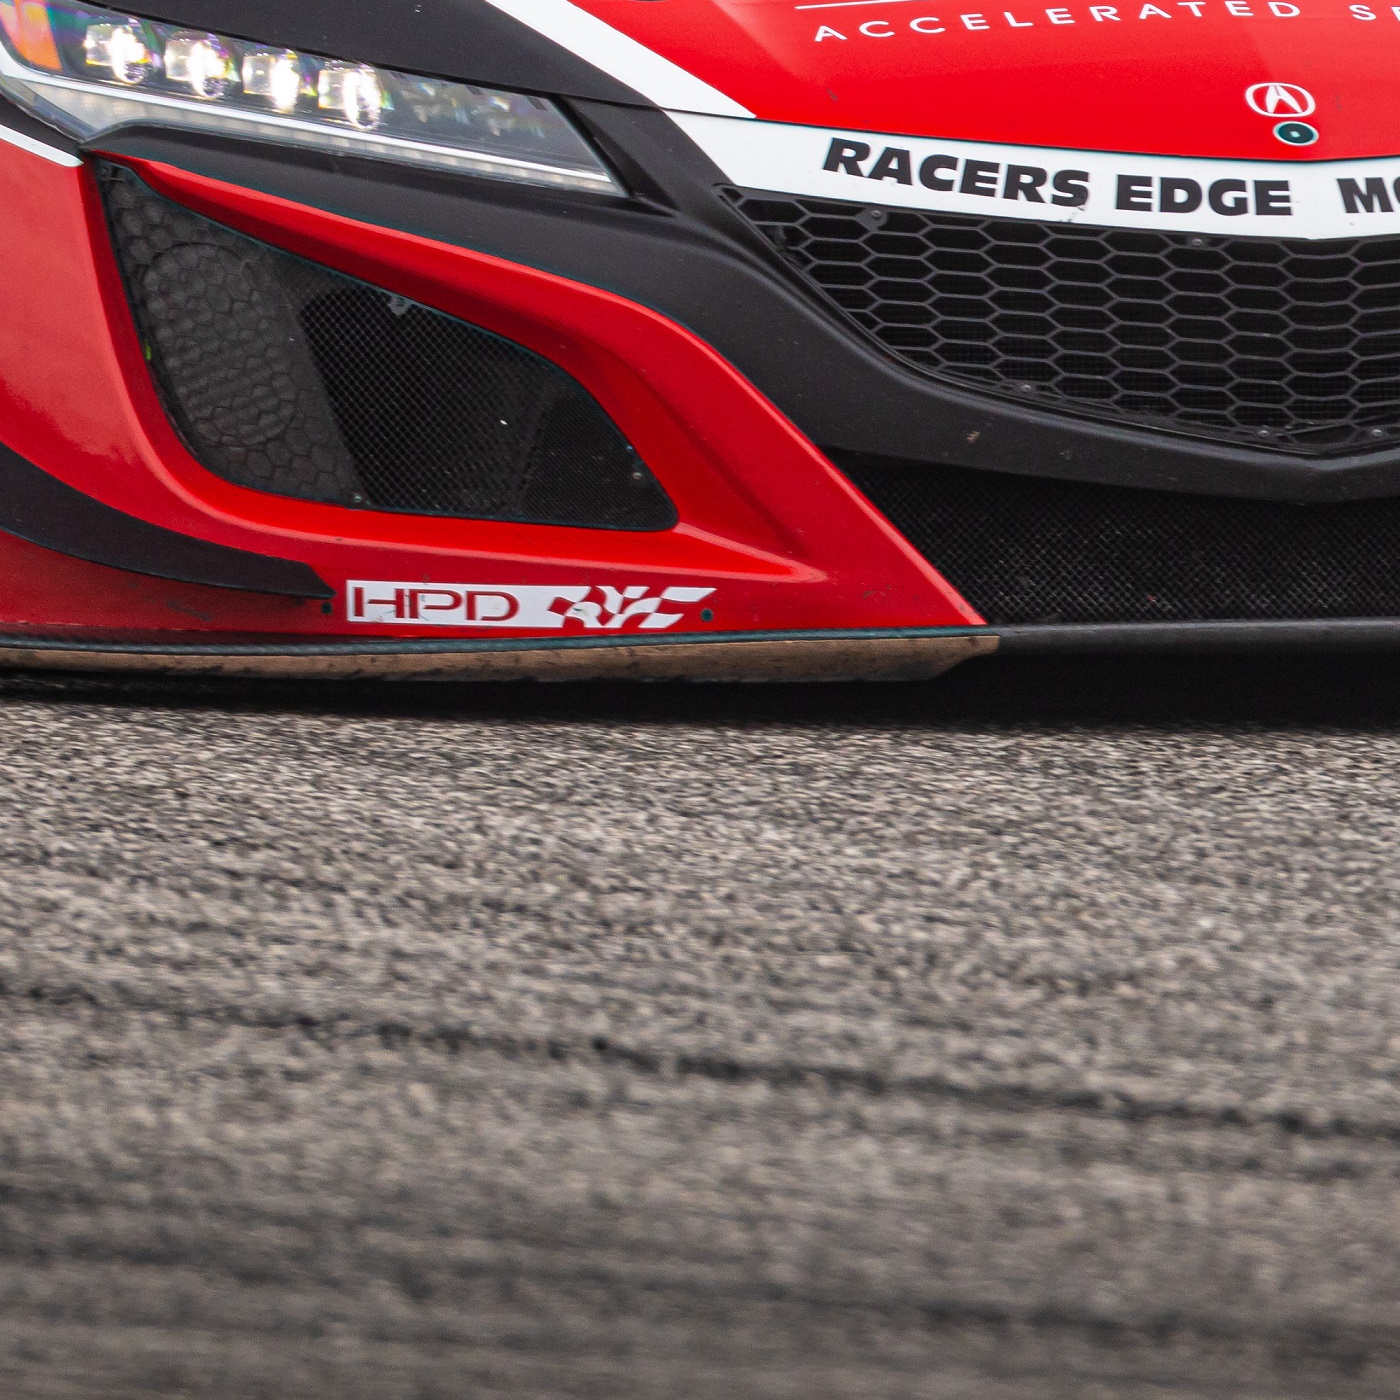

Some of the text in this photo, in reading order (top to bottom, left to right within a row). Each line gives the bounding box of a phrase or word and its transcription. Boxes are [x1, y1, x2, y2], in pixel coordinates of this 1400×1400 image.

[814, 0, 1301, 42] ACCELERATED
[822, 137, 1089, 207] RACERS
[1115, 173, 1293, 217] EDGE
[354, 586, 520, 622] HPD
